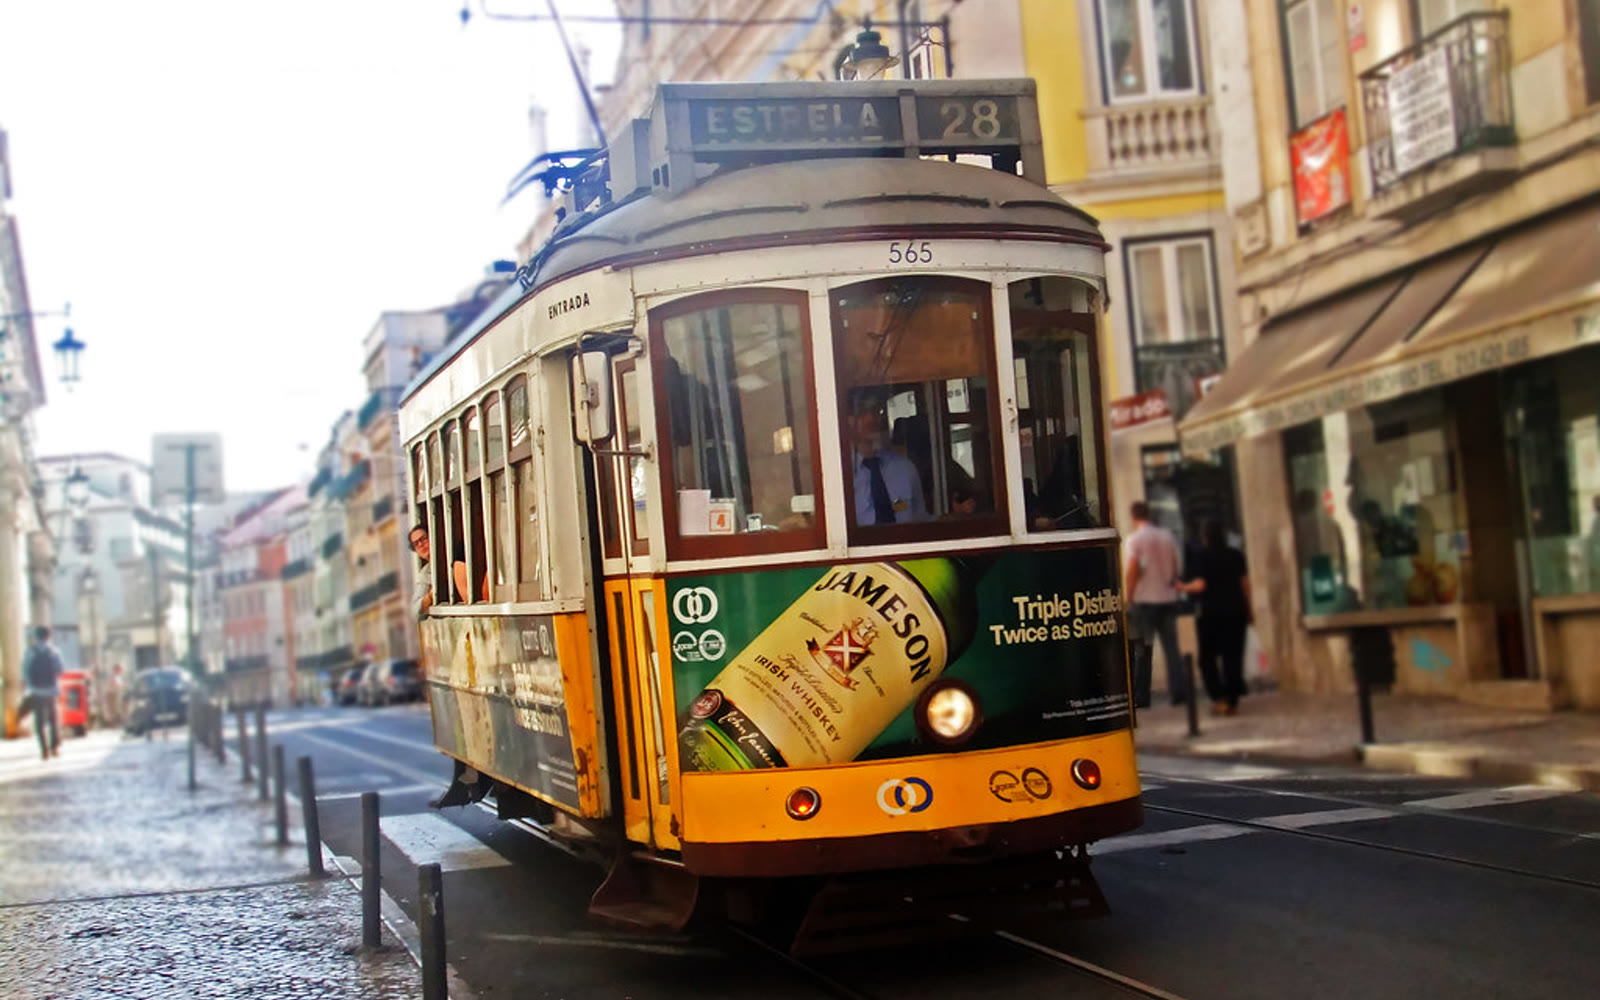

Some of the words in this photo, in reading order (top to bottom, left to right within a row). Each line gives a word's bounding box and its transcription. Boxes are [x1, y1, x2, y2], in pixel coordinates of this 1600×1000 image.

[706, 102, 881, 134] ESTRELA
[940, 99, 1001, 140] 28
[888, 241, 933, 264] 565
[548, 292, 590, 320] ENTRADA
[716, 513, 726, 528] 4
[1012, 593, 1071, 625] Triple
[815, 571, 932, 684] JAMESON
[989, 622, 1048, 646] Twice
[1051, 623, 1070, 640] as
[1073, 614, 1118, 639] Smooth
[753, 653, 790, 682] IRISH
[791, 681, 841, 743] WHISKEY
